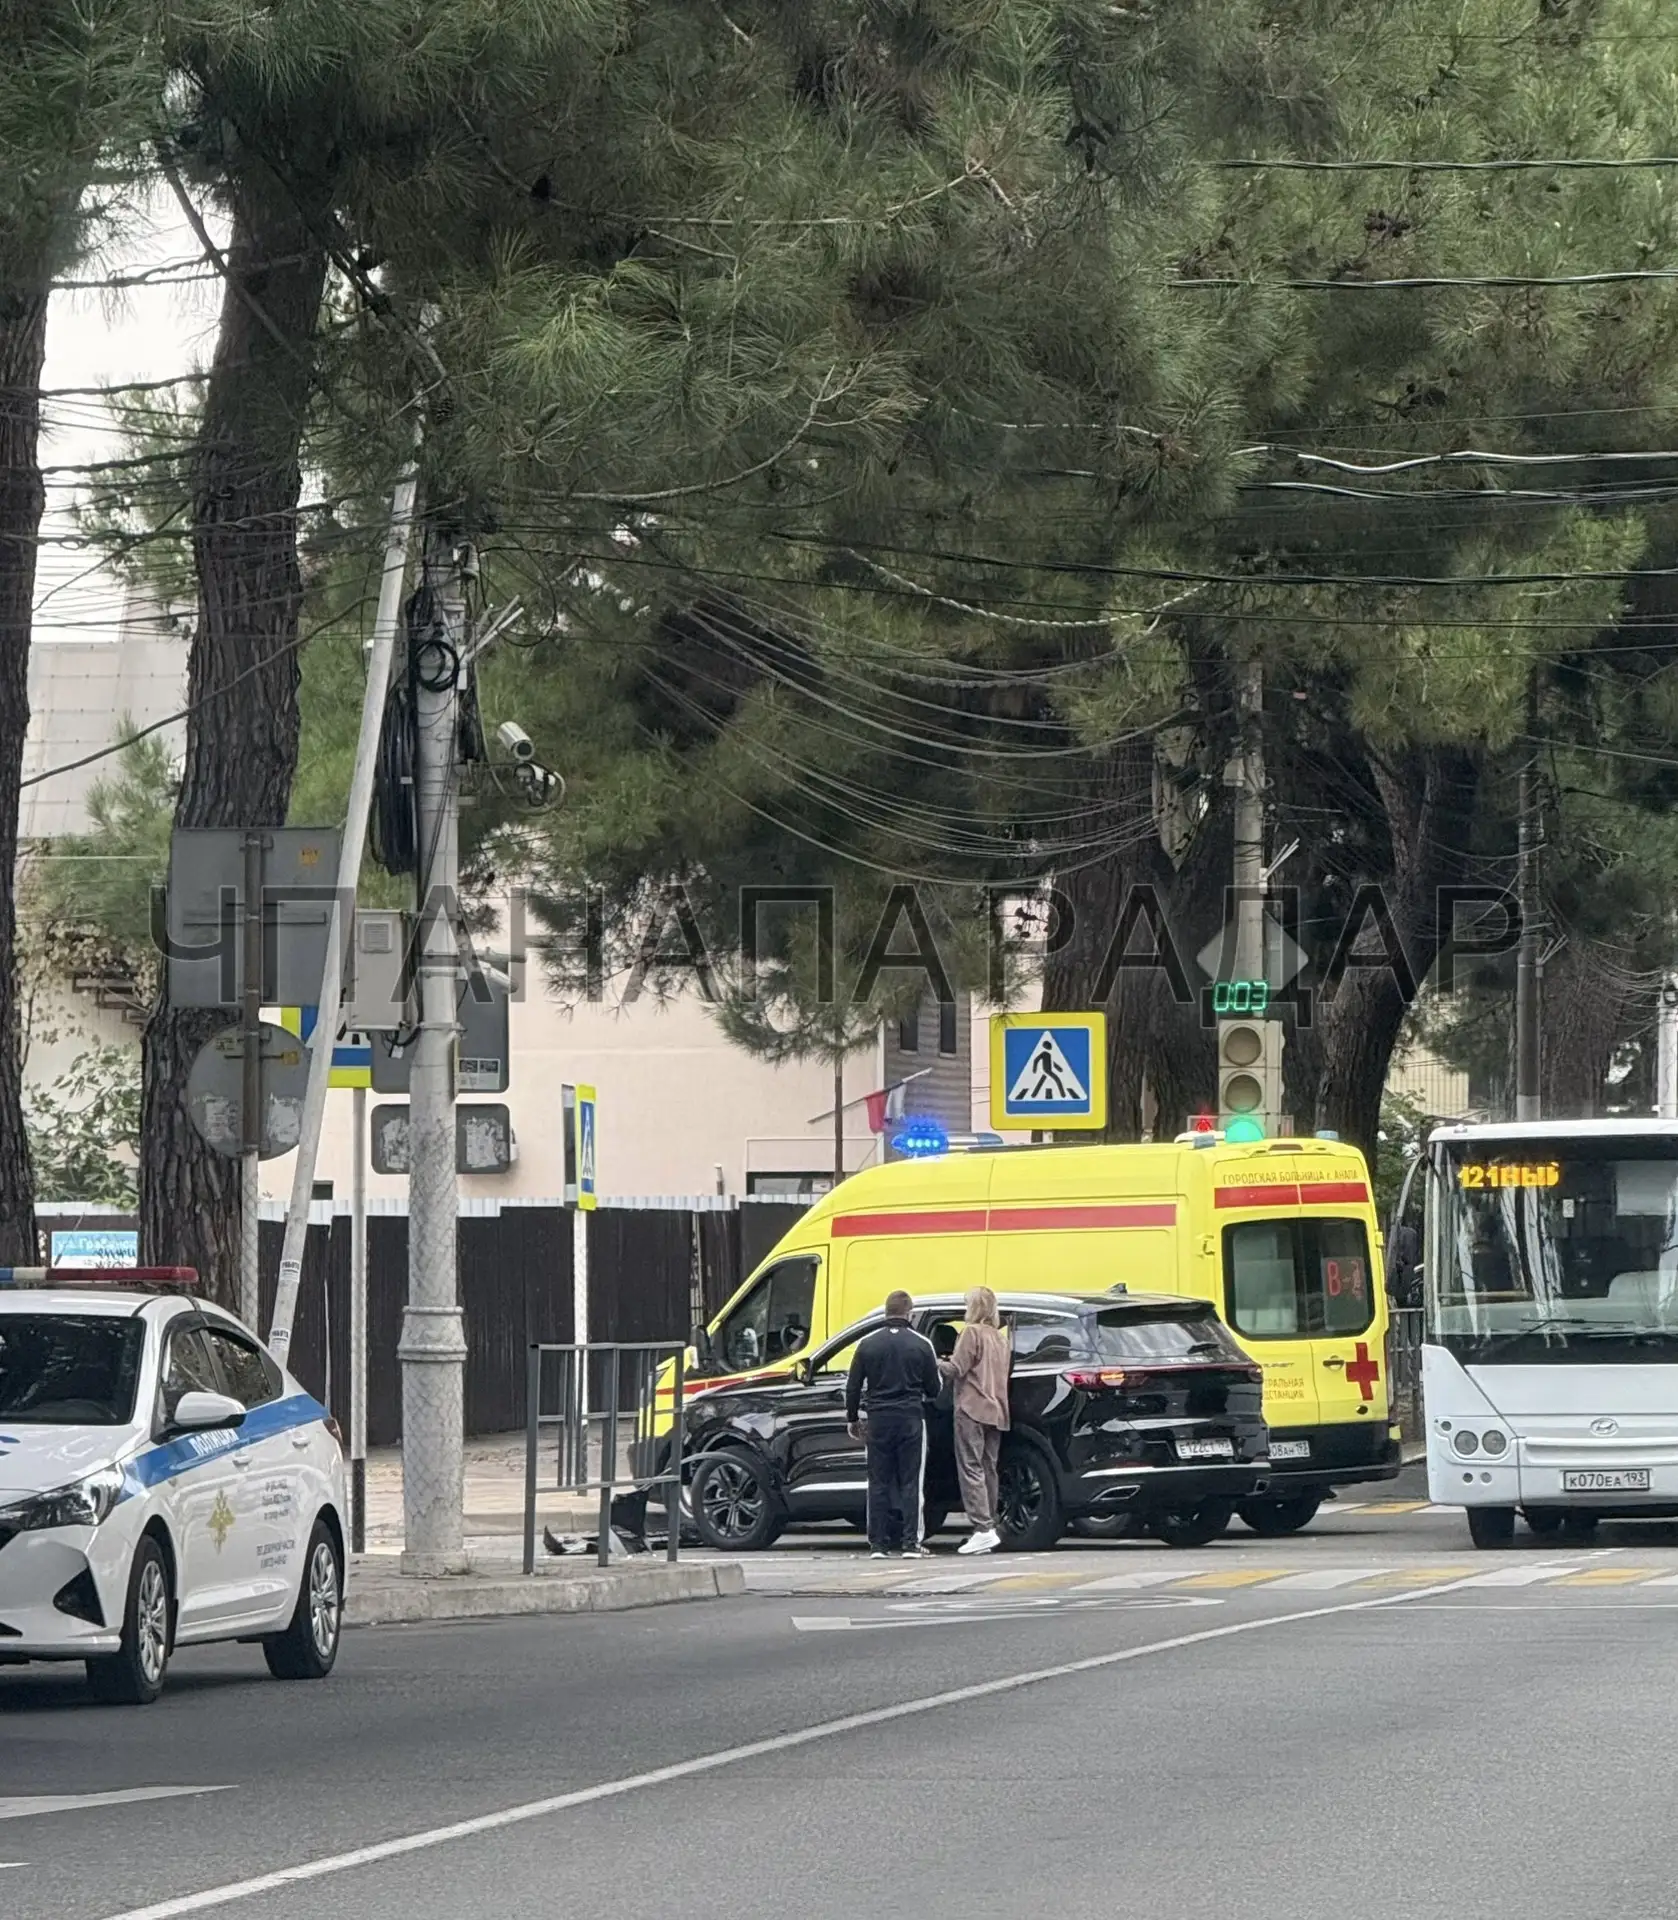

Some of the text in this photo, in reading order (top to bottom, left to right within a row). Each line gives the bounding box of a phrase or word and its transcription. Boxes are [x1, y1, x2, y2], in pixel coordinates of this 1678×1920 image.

[1223, 1172, 1277, 1185] ГОРОДСКАЯ
[1279, 1170, 1325, 1182] БОЛЬНИЦА
[1569, 1471, 1646, 1488] К070ЕА 193
